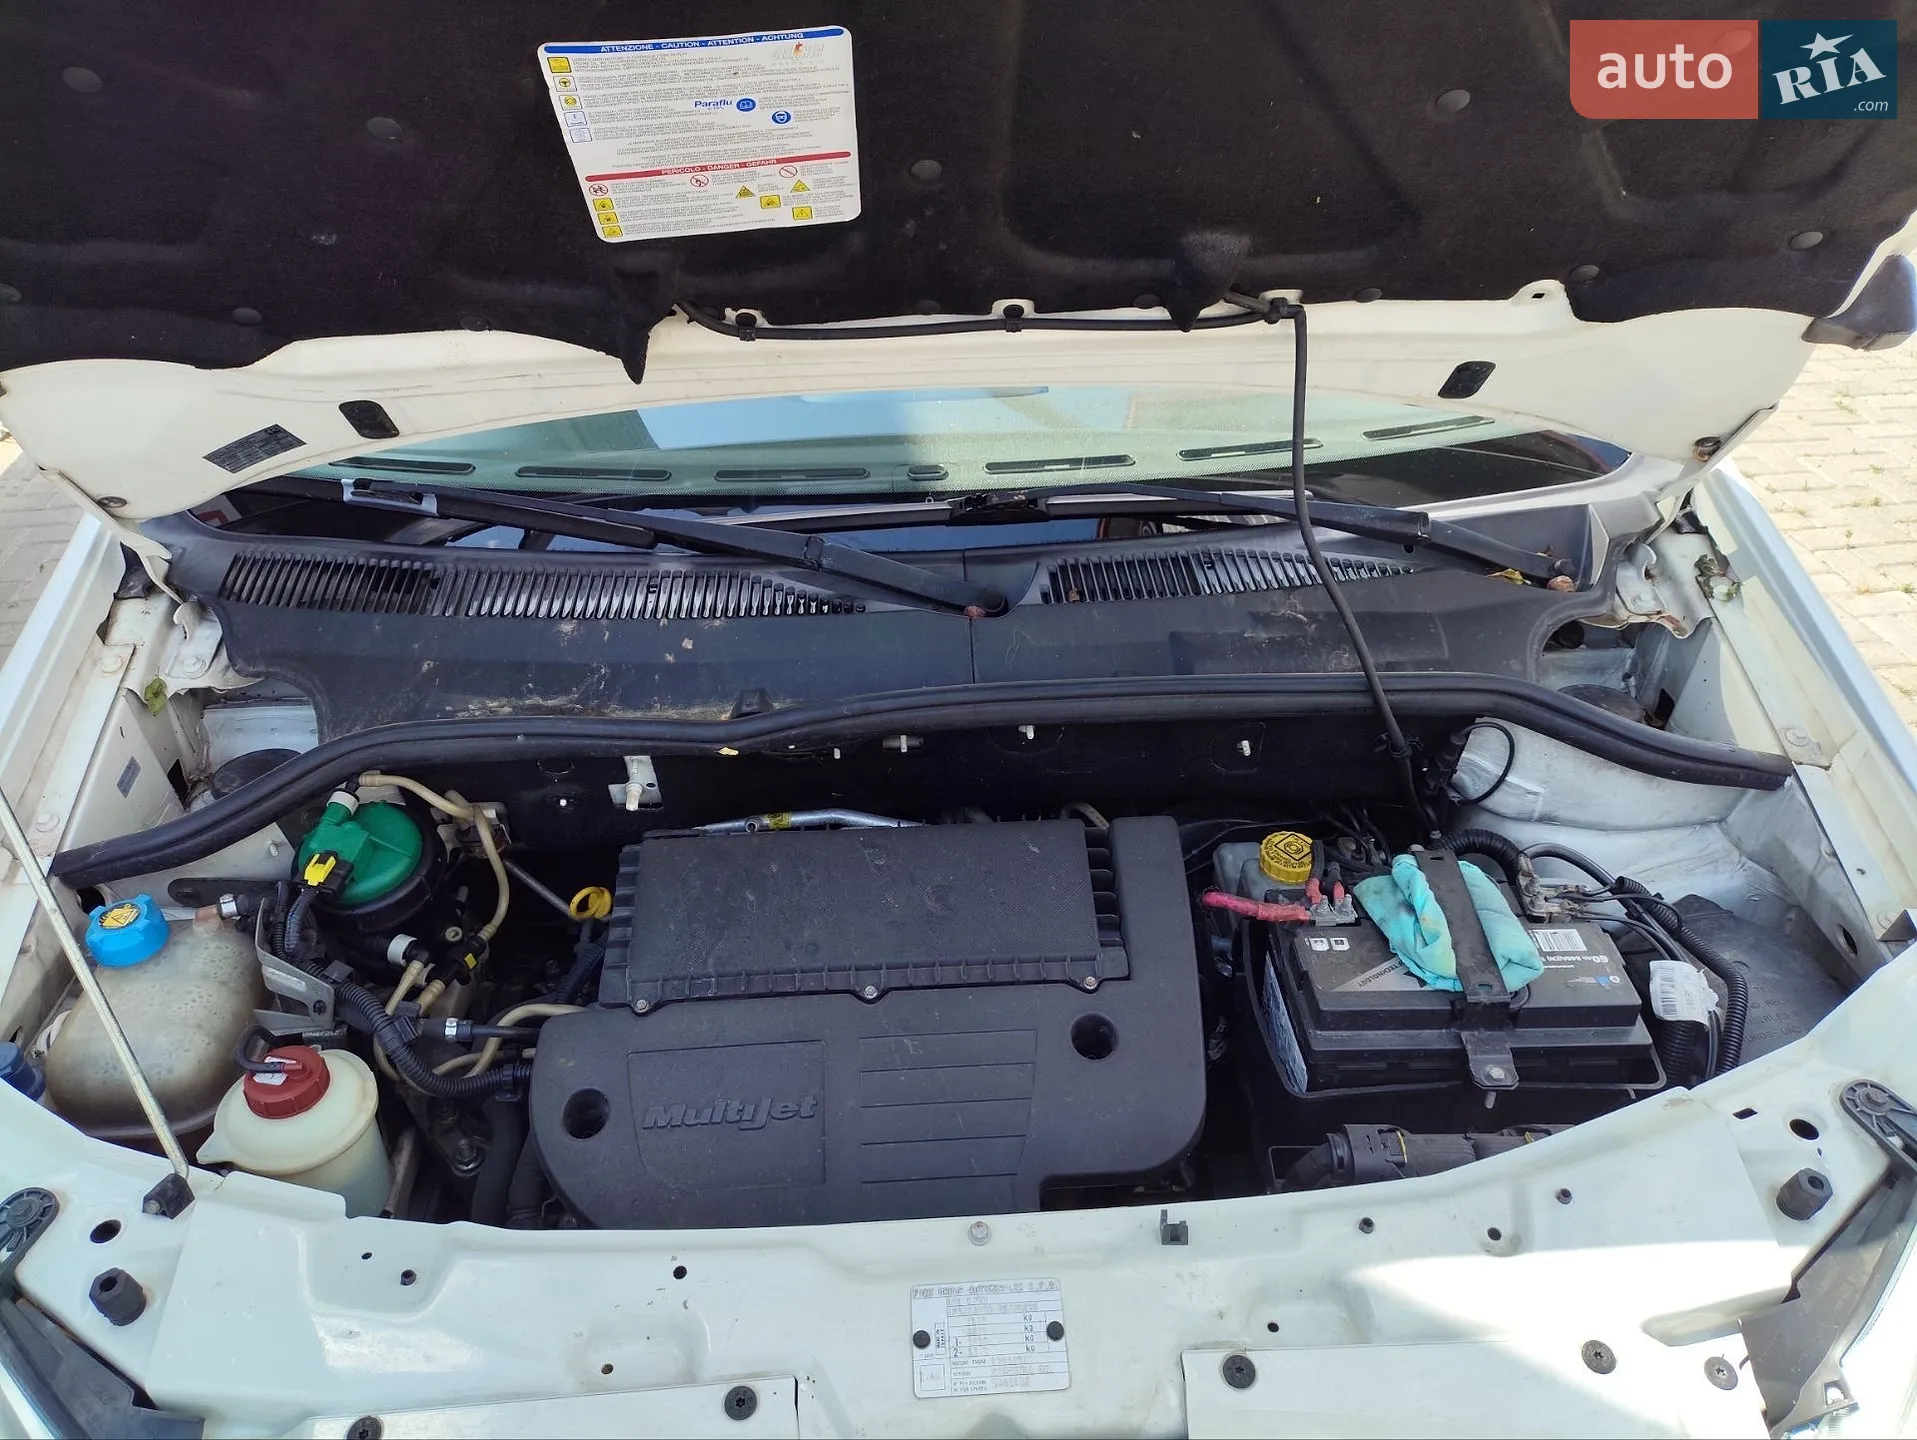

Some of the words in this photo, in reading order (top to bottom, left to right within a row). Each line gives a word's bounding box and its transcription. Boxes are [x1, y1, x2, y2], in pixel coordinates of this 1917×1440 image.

[600, 44, 653, 53] ATTENZIONE
[661, 41, 700, 49] CAUTION
[707, 37, 754, 46] ATTENTION
[762, 32, 804, 41] ACHTUNG
[694, 99, 733, 108] Paraflu
[661, 166, 701, 175] PERICOLO
[707, 163, 740, 171] DANGER
